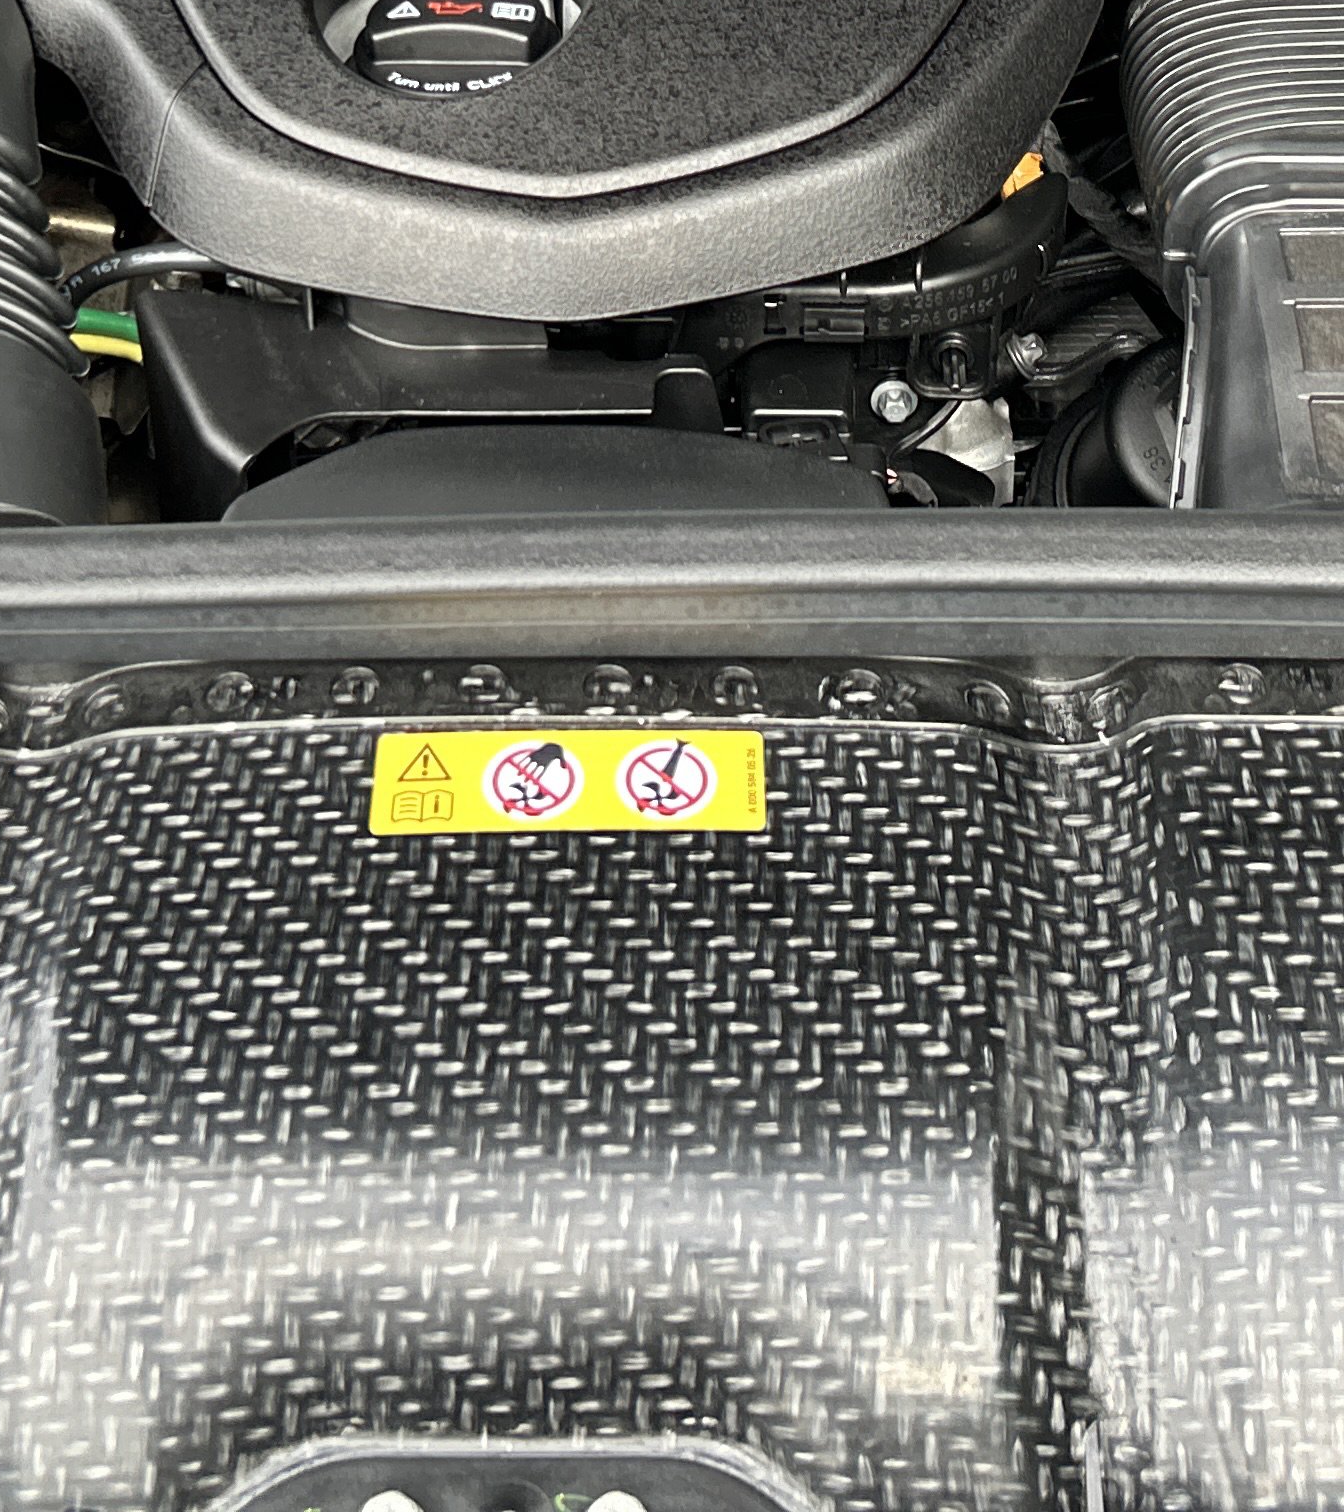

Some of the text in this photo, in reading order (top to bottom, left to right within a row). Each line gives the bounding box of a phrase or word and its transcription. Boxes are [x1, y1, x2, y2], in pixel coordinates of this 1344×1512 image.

[387, 71, 420, 89] Turn
[423, 81, 461, 92] until
[90, 254, 122, 279] 167
